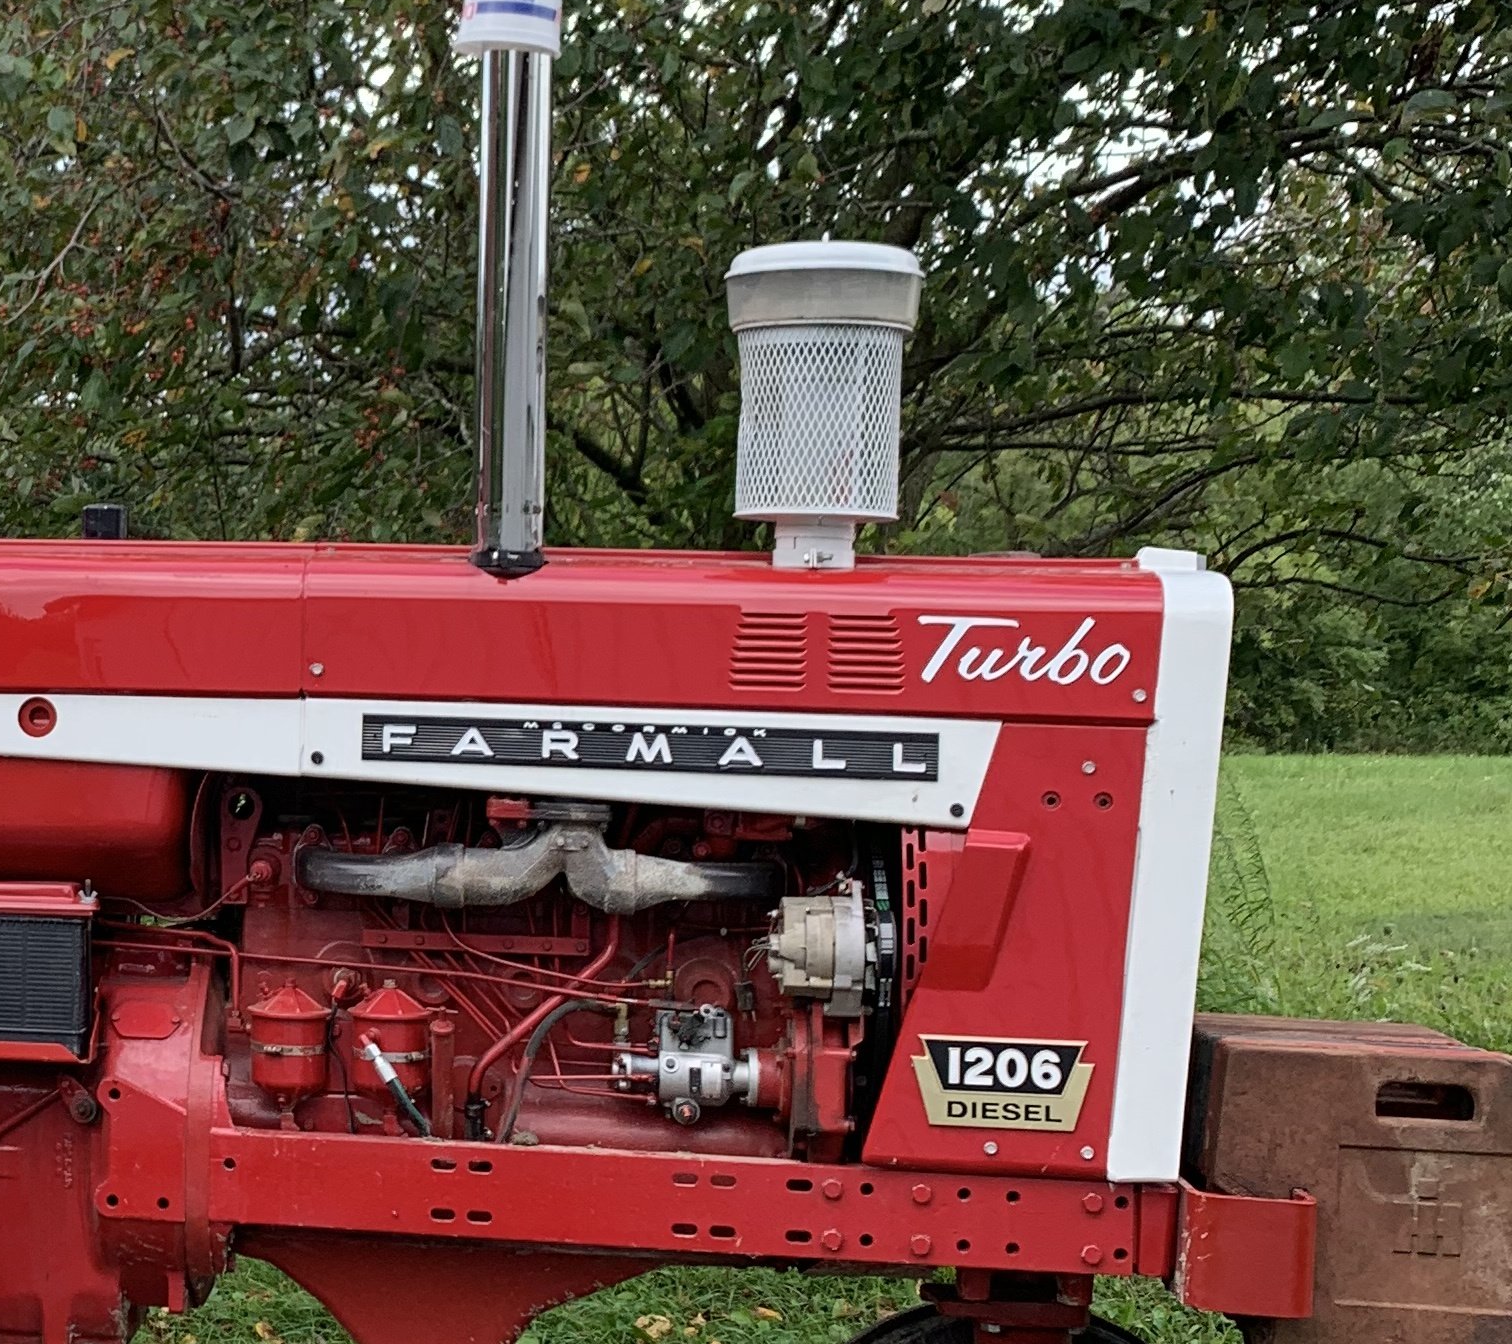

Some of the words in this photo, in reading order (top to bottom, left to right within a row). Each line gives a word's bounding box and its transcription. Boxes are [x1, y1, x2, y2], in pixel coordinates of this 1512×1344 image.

[917, 615, 1131, 685] Turbo
[381, 724, 928, 772] FARMALL
[947, 1046, 1062, 1090] 1206
[947, 1100, 1063, 1123] DIESEL
